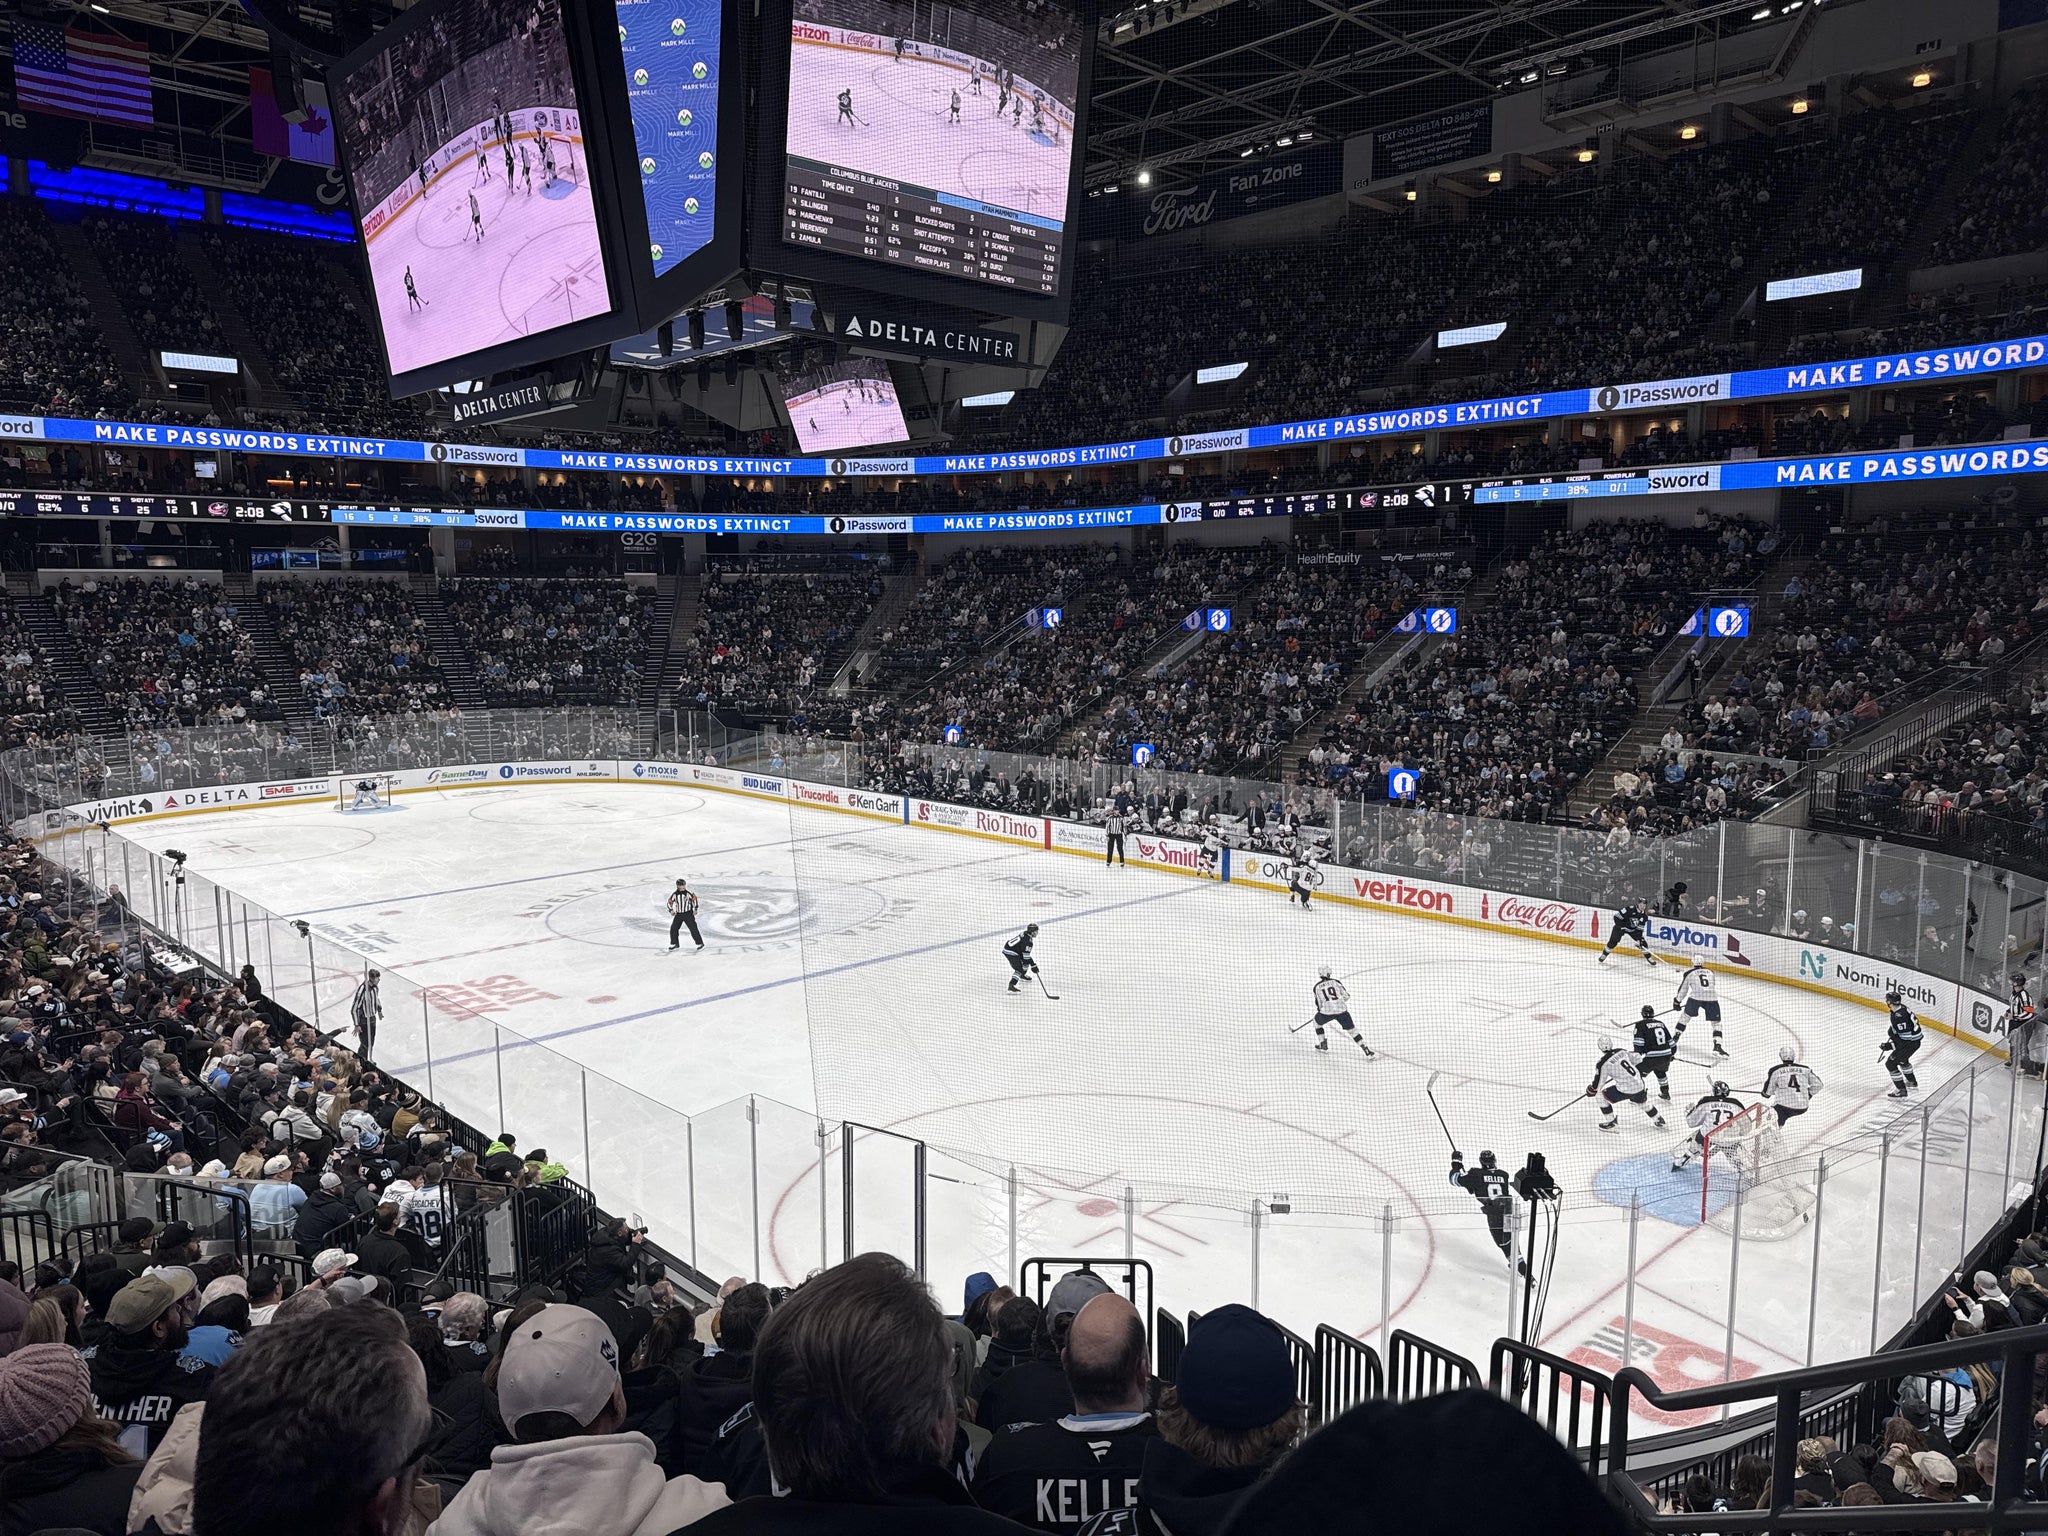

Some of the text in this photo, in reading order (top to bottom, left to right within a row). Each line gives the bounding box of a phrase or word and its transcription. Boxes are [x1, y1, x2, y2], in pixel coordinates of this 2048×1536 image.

[1377, 131, 1396, 143] TEXT
[1398, 126, 1415, 138] SOS
[1416, 120, 1440, 133] DELTA
[1441, 116, 1453, 126] TO
[830, 168, 900, 190] COLUMBUS BLUE JACKETS
[1230, 163, 1302, 194] Fan Zone
[790, 185, 826, 200] 19 FANTILLI
[822, 180, 854, 194] TIME ON ICE
[800, 200, 828, 212] SILLINGER
[930, 206, 942, 214] HITS
[982, 204, 1018, 220] UTAH MAMMOTH
[1143, 185, 1217, 235] Ford
[800, 211, 834, 224] MARCHENKO
[915, 216, 938, 228] BLOCKED
[938, 220, 956, 231] SHOTS
[800, 222, 828, 234] WERENSKI
[892, 224, 954, 244] 25 SHOT ATTEMPTS
[1010, 224, 1036, 237] TIME ICE
[915, 256, 950, 270] POWER PLAYS
[990, 252, 1008, 262] KELLER
[870, 320, 1014, 358] DELTA CENTER
[462, 386, 542, 418] DELTA CENTER
[96, 364, 1864, 474] MAKE PASSWORDS EXTINCT 1Password MAKE PASSWORDS EXTINCT 1Password MAKE PASSWORDS EXTINCT 1Password MAKE PASSWORDS EXTINCT 1Password MAKE
[1777, 462, 1851, 483] MAKE
[1864, 447, 2048, 478] PASSWORDS
[1444, 486, 1450, 502] 1
[1514, 489, 1520, 498] 5
[1542, 488, 1548, 496] 2
[1568, 485, 1589, 495] 38%
[1610, 483, 1628, 493] 0/1
[1346, 494, 1352, 508] 1
[1383, 494, 1408, 506] 2:08
[1464, 491, 1470, 500] 7
[1488, 491, 1498, 500] 16
[38, 502, 62, 512] 62%
[82, 504, 88, 513] 6
[112, 505, 120, 514] 5
[137, 506, 150, 514] 25
[166, 506, 178, 514] 12
[190, 501, 198, 516] 1
[301, 505, 308, 518] 1
[1238, 507, 1254, 516] 62%
[1266, 506, 1272, 514] 6
[1304, 504, 1314, 512] 25
[1327, 500, 1336, 509] 12
[236, 506, 264, 518] 2:08
[344, 513, 354, 521] 16
[368, 514, 374, 522] 5
[392, 514, 398, 522] 2
[1214, 508, 1226, 518] 0/0
[414, 515, 431, 524] 38%
[447, 516, 460, 524] 0/1
[561, 510, 1133, 532] MAKE PASSWORDS EXTINCT 1Password MAKE PASSWORDS EXTINCT
[620, 532, 657, 546] G2G
[1298, 552, 1361, 566] HealthEquity
[442, 770, 488, 778] SameDay
[516, 766, 572, 776] 1Password
[648, 766, 678, 776] moxie
[265, 786, 294, 796] SME
[744, 777, 758, 788] BUD
[760, 780, 782, 792] LIGHT
[185, 789, 248, 806] DELTA
[800, 786, 839, 804] Trucordia
[87, 800, 136, 823] vivint
[856, 795, 899, 814] Ken Garff
[931, 804, 968, 817] CRAIG SWAPP
[1159, 841, 1209, 870] Smith
[528, 883, 623, 911] DELTA
[1354, 878, 1452, 913] verizon
[1498, 897, 1580, 934] Coca-Cola
[1646, 920, 1718, 948] Layton
[1698, 974, 1710, 988] 6
[1836, 964, 1936, 1006] Nomi Health
[463, 974, 563, 1006] SEAT
[1322, 986, 1338, 1002] 19
[410, 984, 510, 1022] GEEK
[1898, 1022, 1907, 1030] 67
[1654, 1028, 1666, 1046] 8
[1620, 1060, 1636, 1076] 8
[1788, 1074, 1800, 1092] 4
[380, 1168, 393, 1180] 98
[1484, 1175, 1505, 1184] KELLER
[1487, 1184, 1502, 1200] 9
[411, 1199, 440, 1208] ERGACHEV
[414, 1210, 442, 1239] 98
[1036, 1478, 1140, 1523] KELLE
